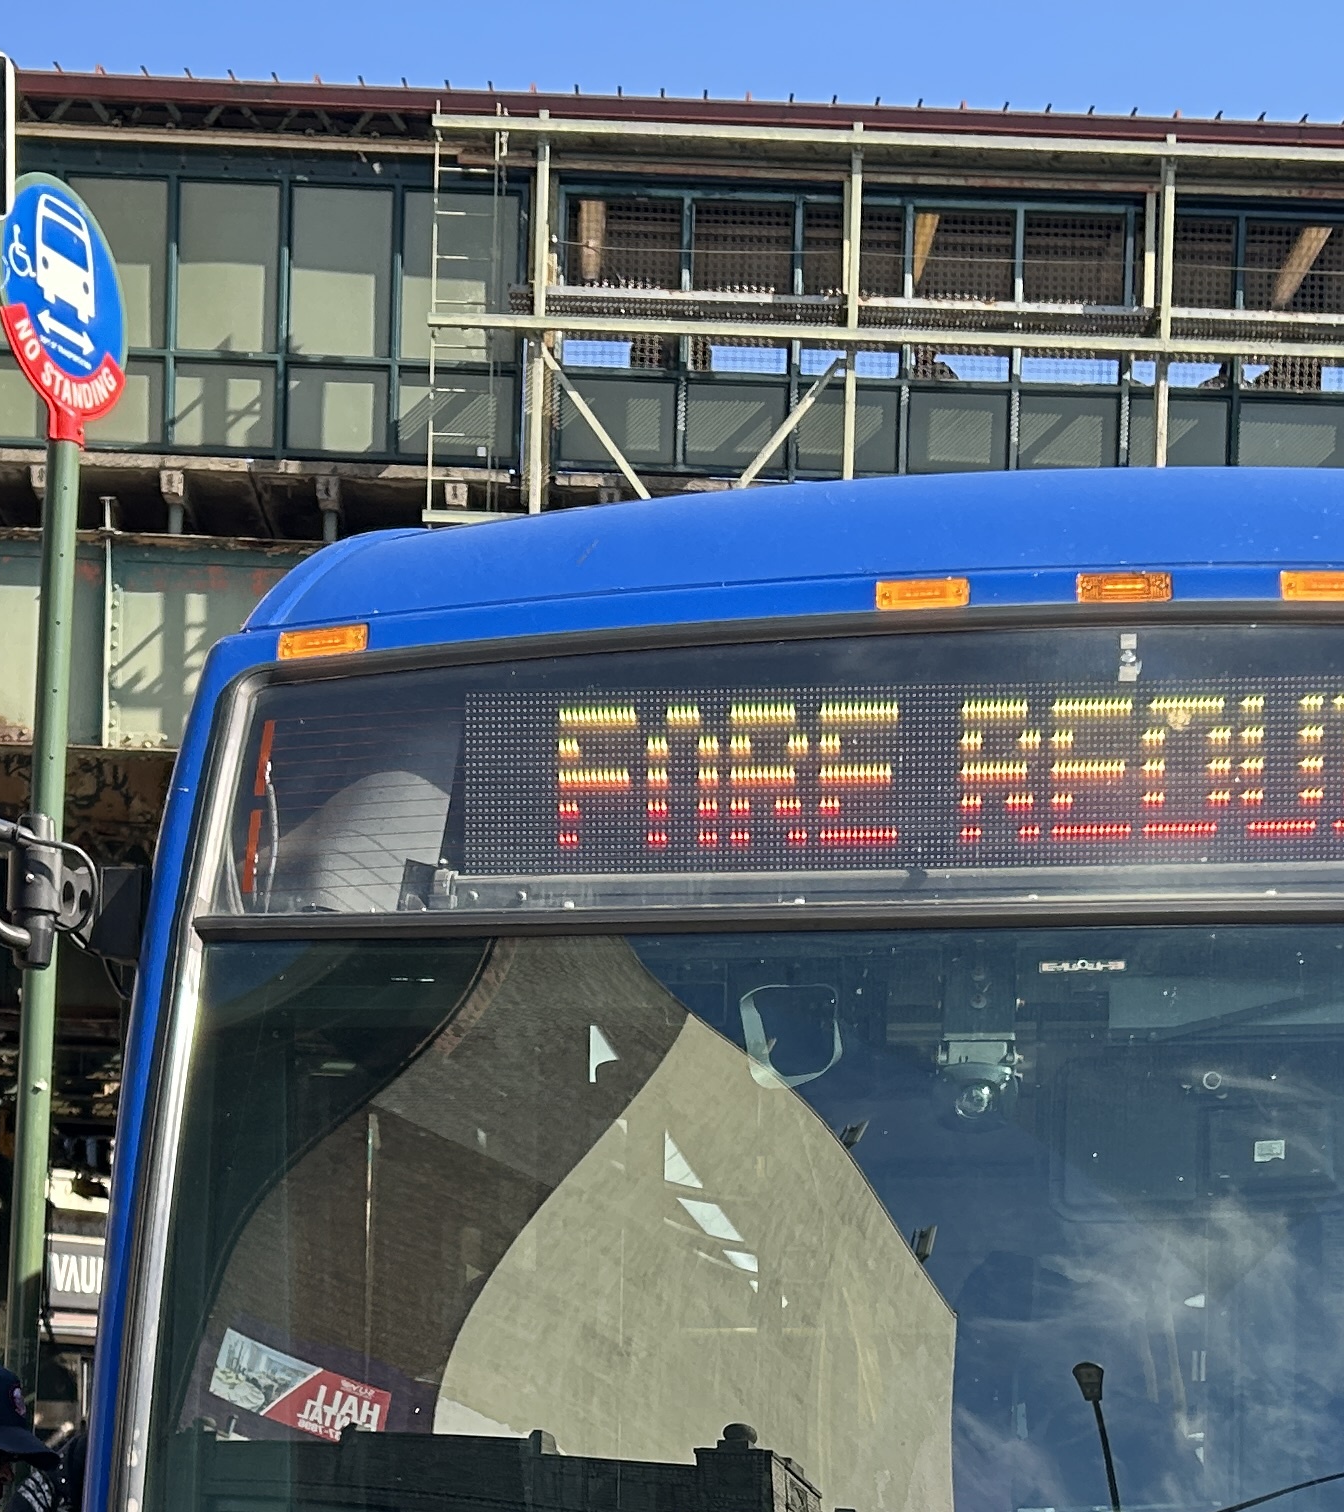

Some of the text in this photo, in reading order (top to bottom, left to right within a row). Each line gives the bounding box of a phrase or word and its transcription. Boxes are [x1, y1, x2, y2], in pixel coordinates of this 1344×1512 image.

[15, 317, 41, 361] NO
[41, 361, 117, 409] STANDING
[558, 700, 899, 847] FARE
